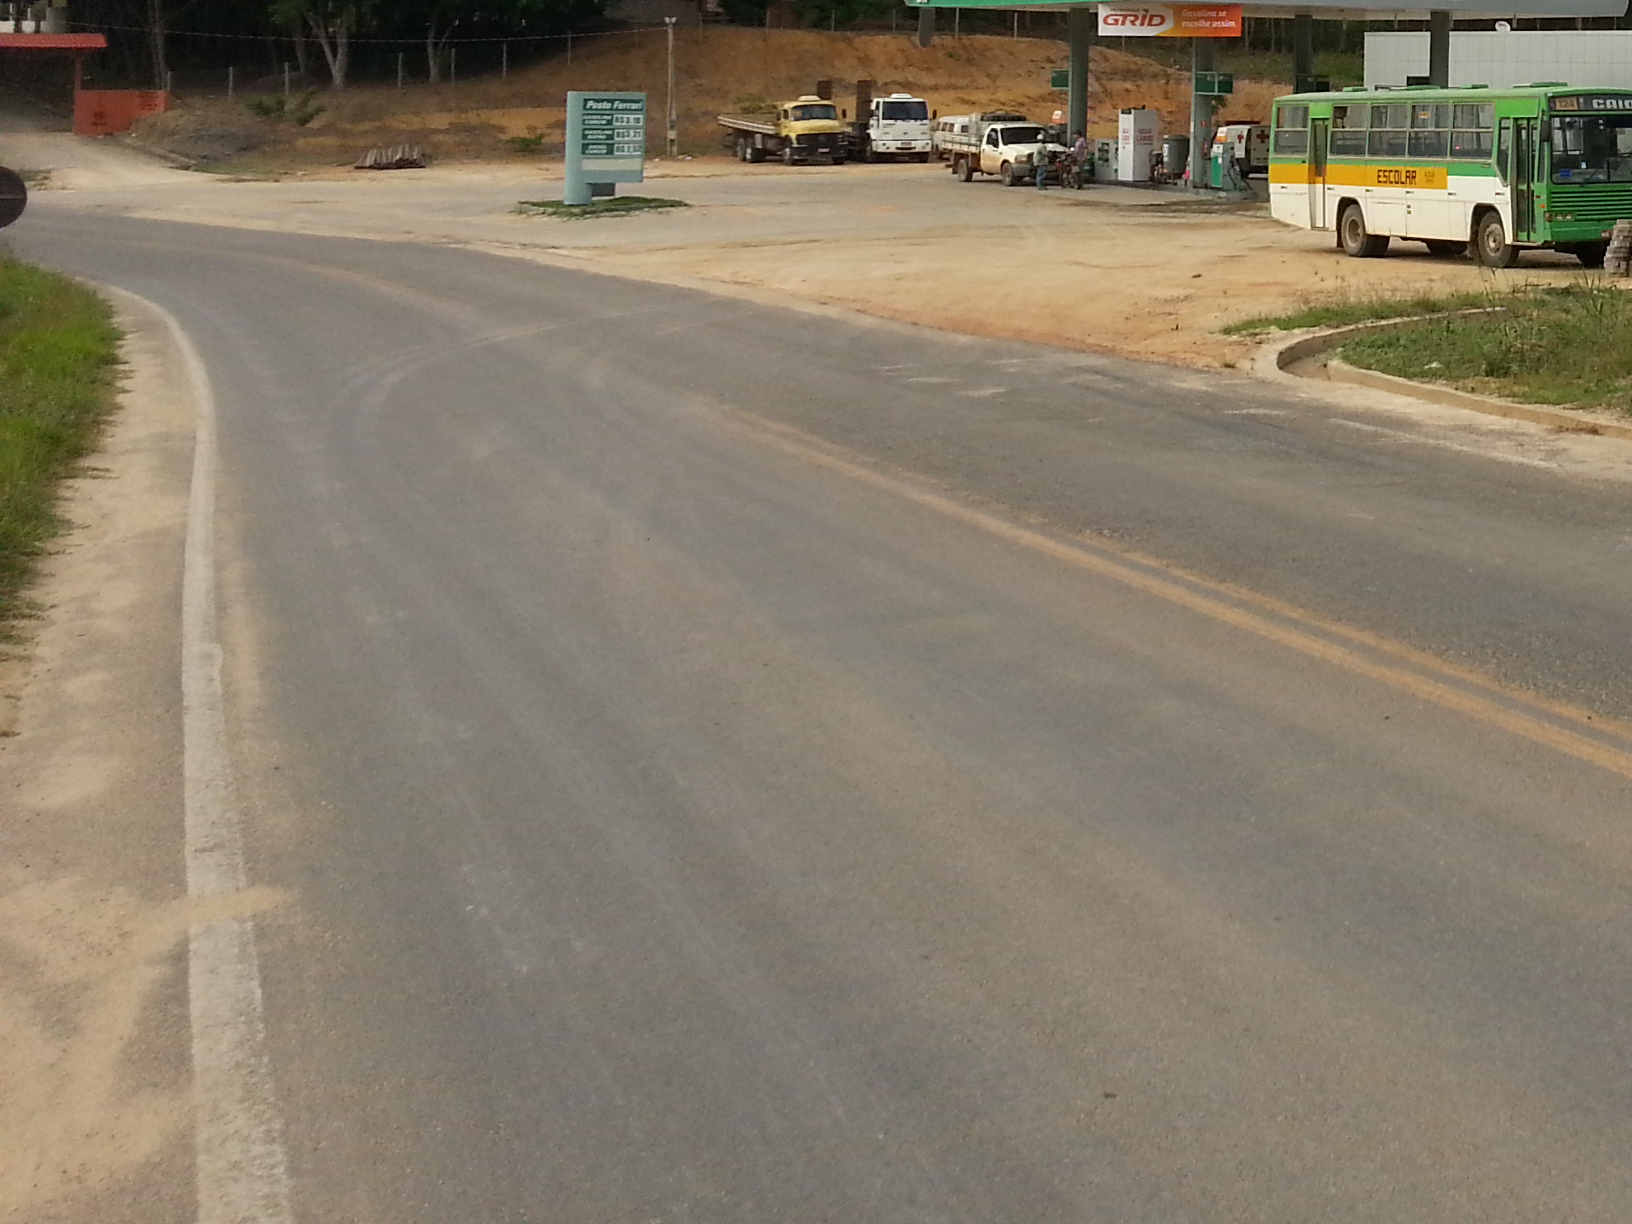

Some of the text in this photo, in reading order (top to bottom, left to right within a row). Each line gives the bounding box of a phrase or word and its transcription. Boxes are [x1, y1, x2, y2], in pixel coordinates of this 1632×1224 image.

[586, 101, 642, 109] Posto Ferrari
[1377, 169, 1417, 185] ESCOLAR
